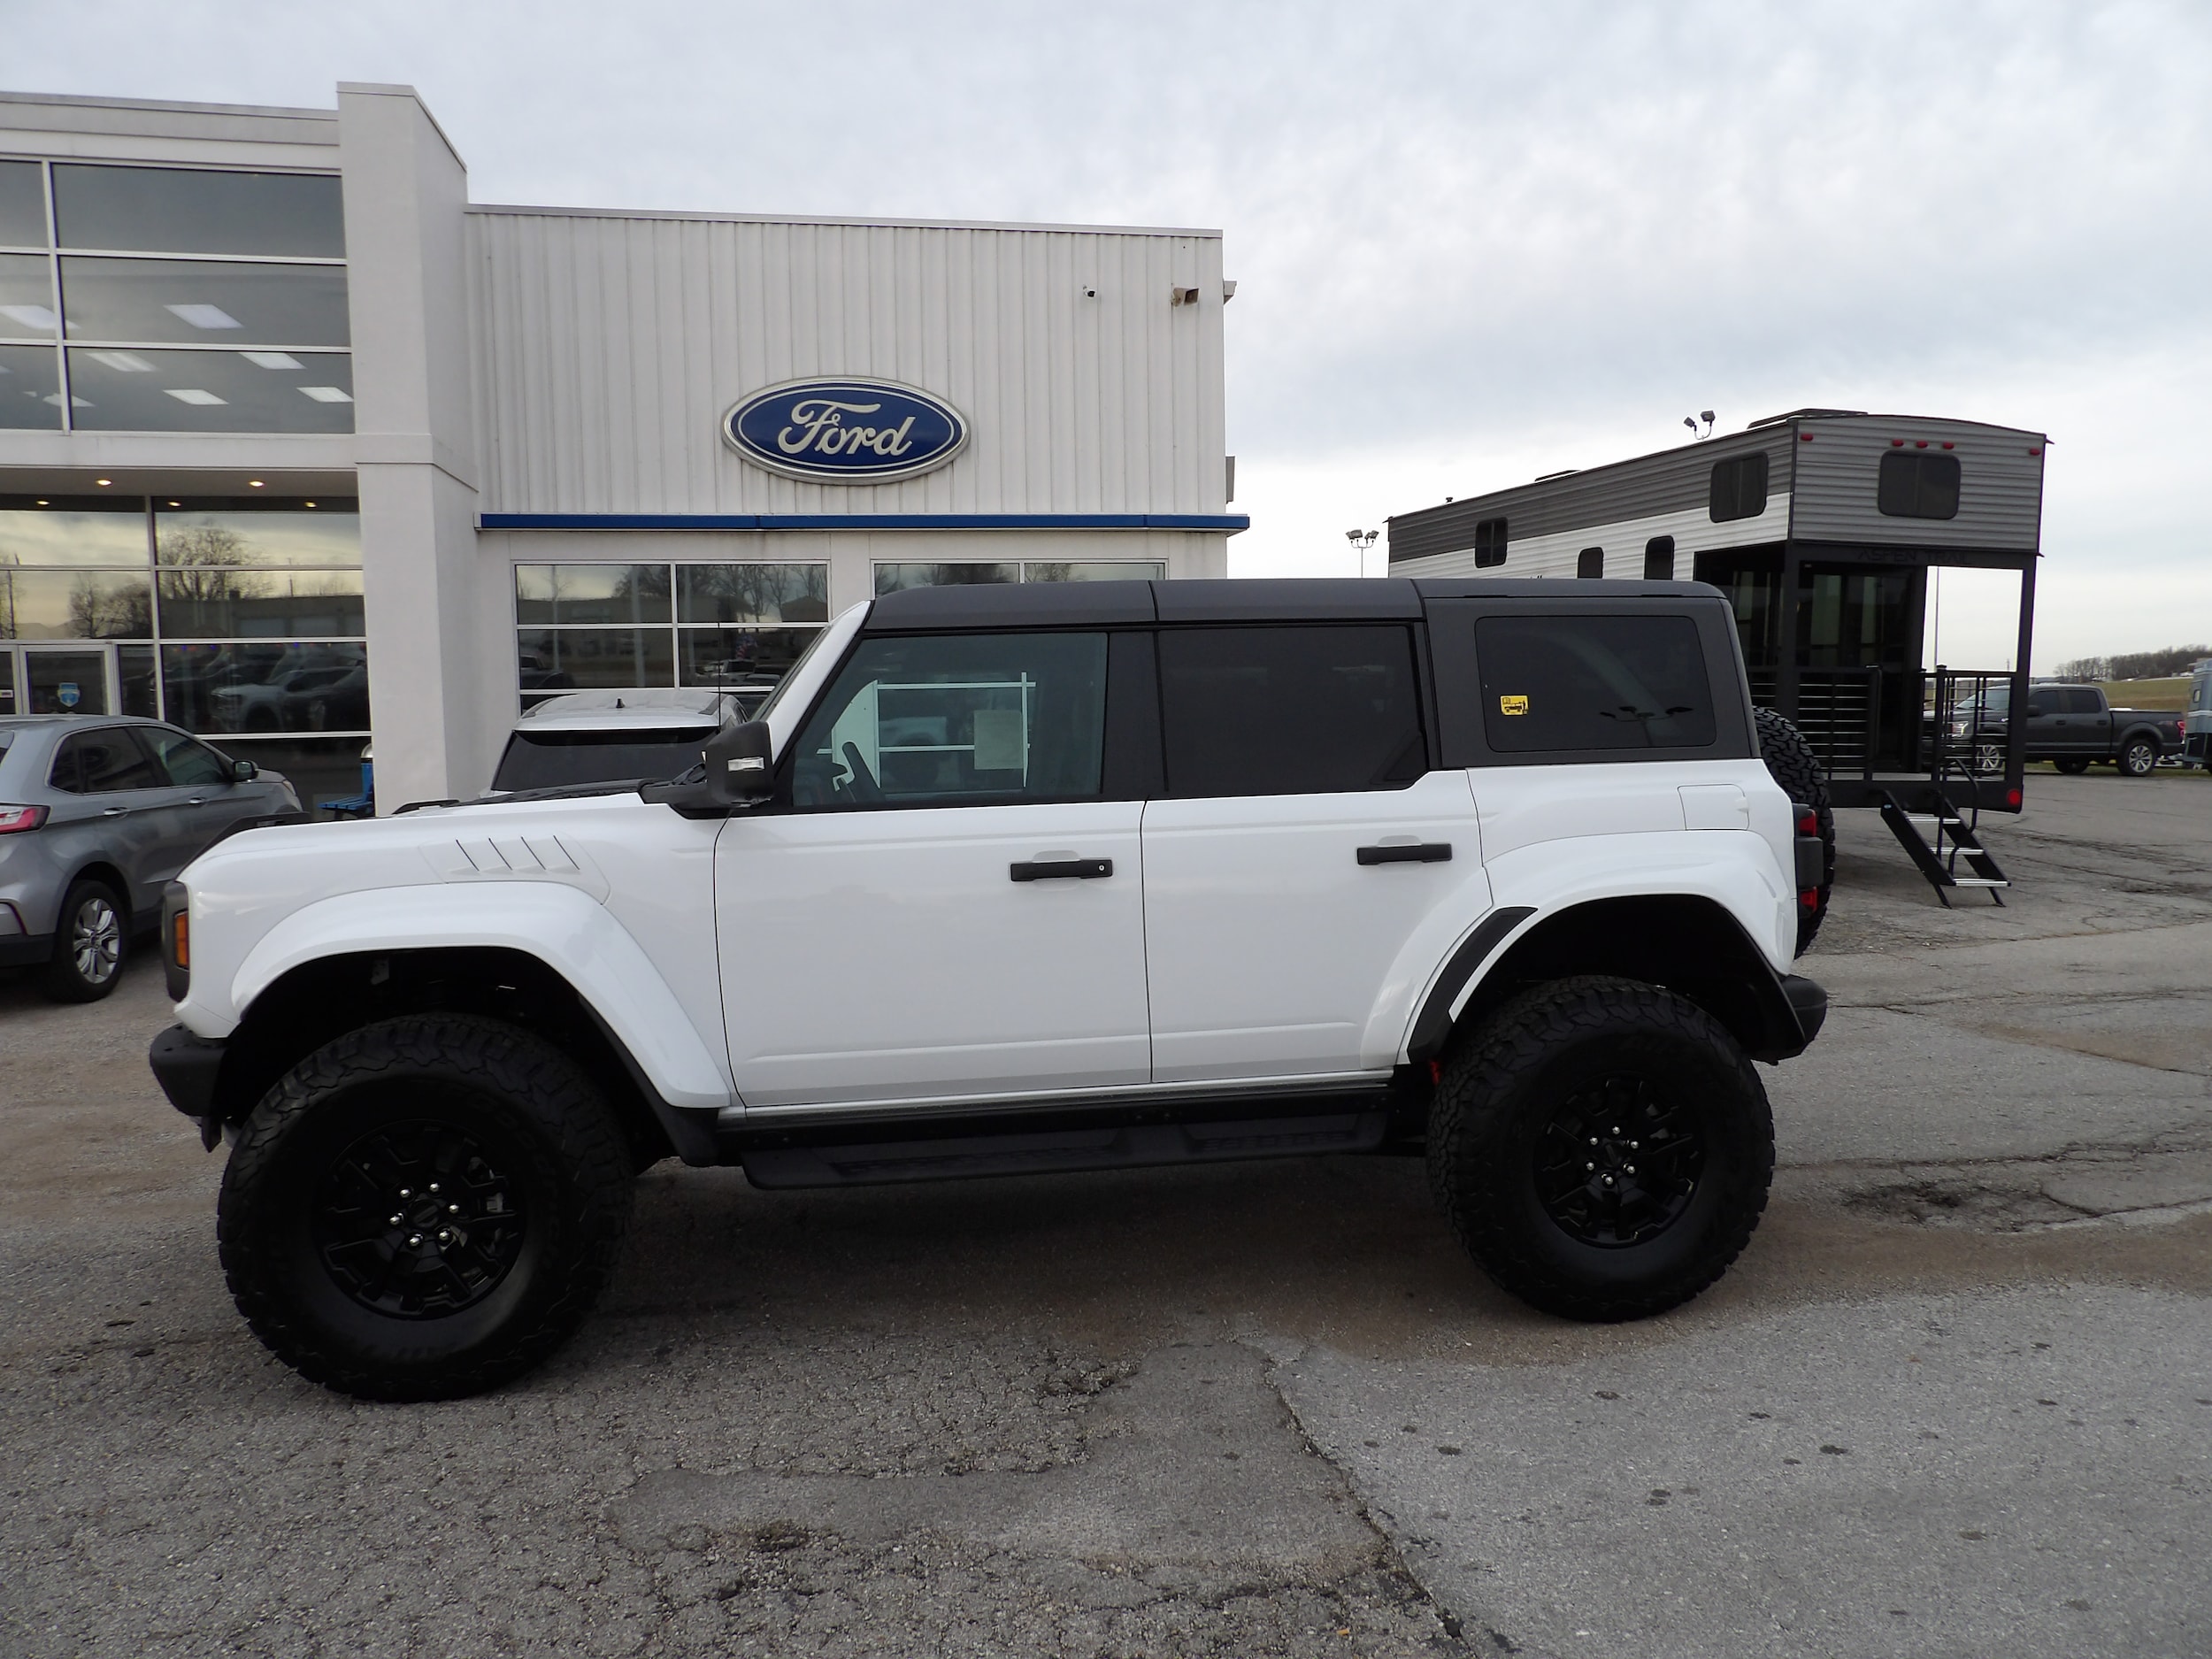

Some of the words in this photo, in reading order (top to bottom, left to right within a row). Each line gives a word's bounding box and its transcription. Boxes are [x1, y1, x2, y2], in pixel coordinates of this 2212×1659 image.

[778, 399, 916, 457] Ford
[1857, 548, 1917, 563] ASPEN
[1924, 550, 1972, 565] TRAIL
